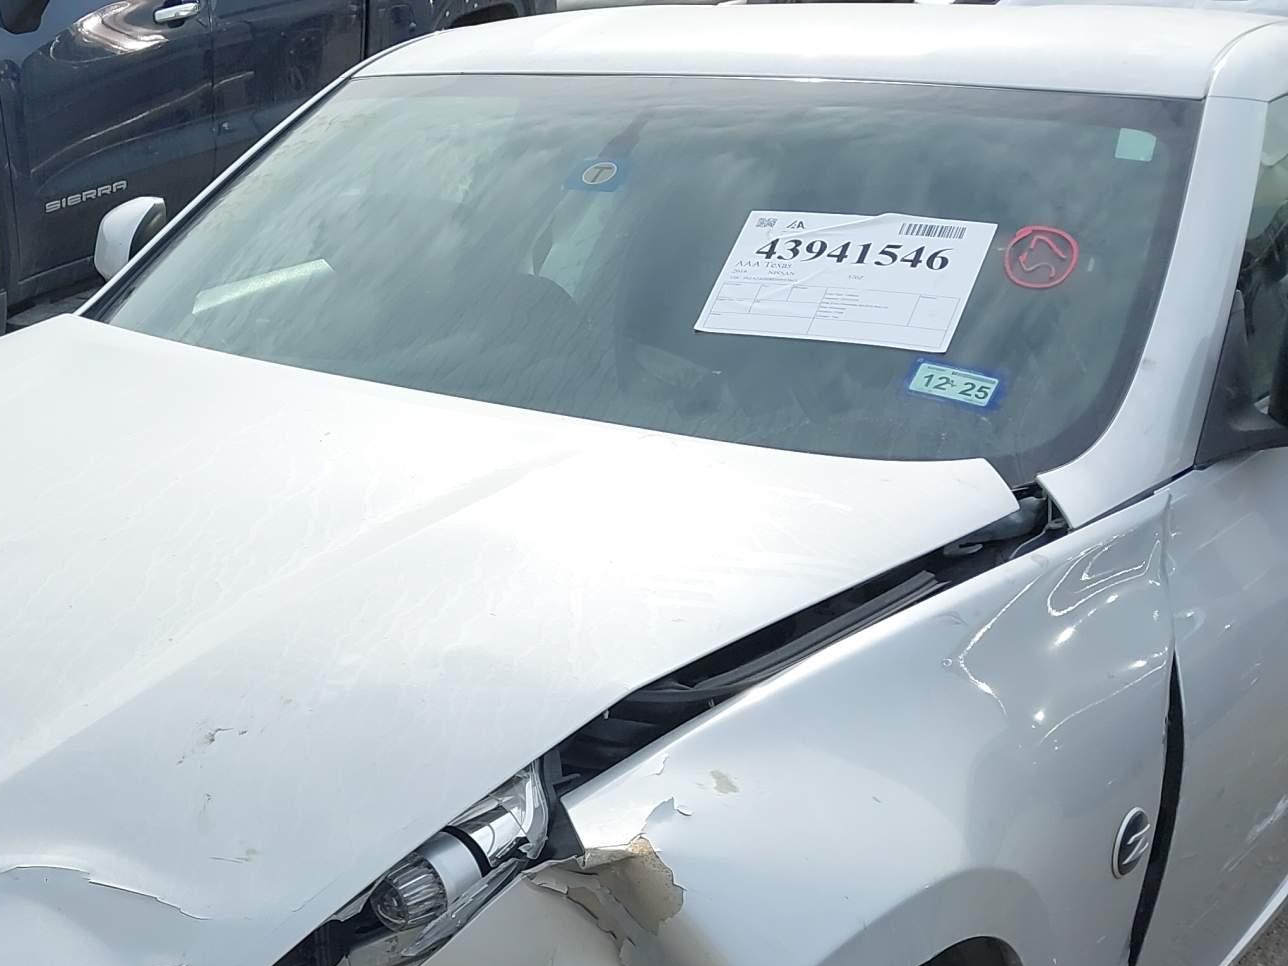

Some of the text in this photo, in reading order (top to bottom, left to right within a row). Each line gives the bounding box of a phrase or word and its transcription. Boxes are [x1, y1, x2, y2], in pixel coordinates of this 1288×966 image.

[44, 180, 128, 214] SIERRA
[755, 237, 953, 271] 43941546
[958, 382, 991, 399] 25
